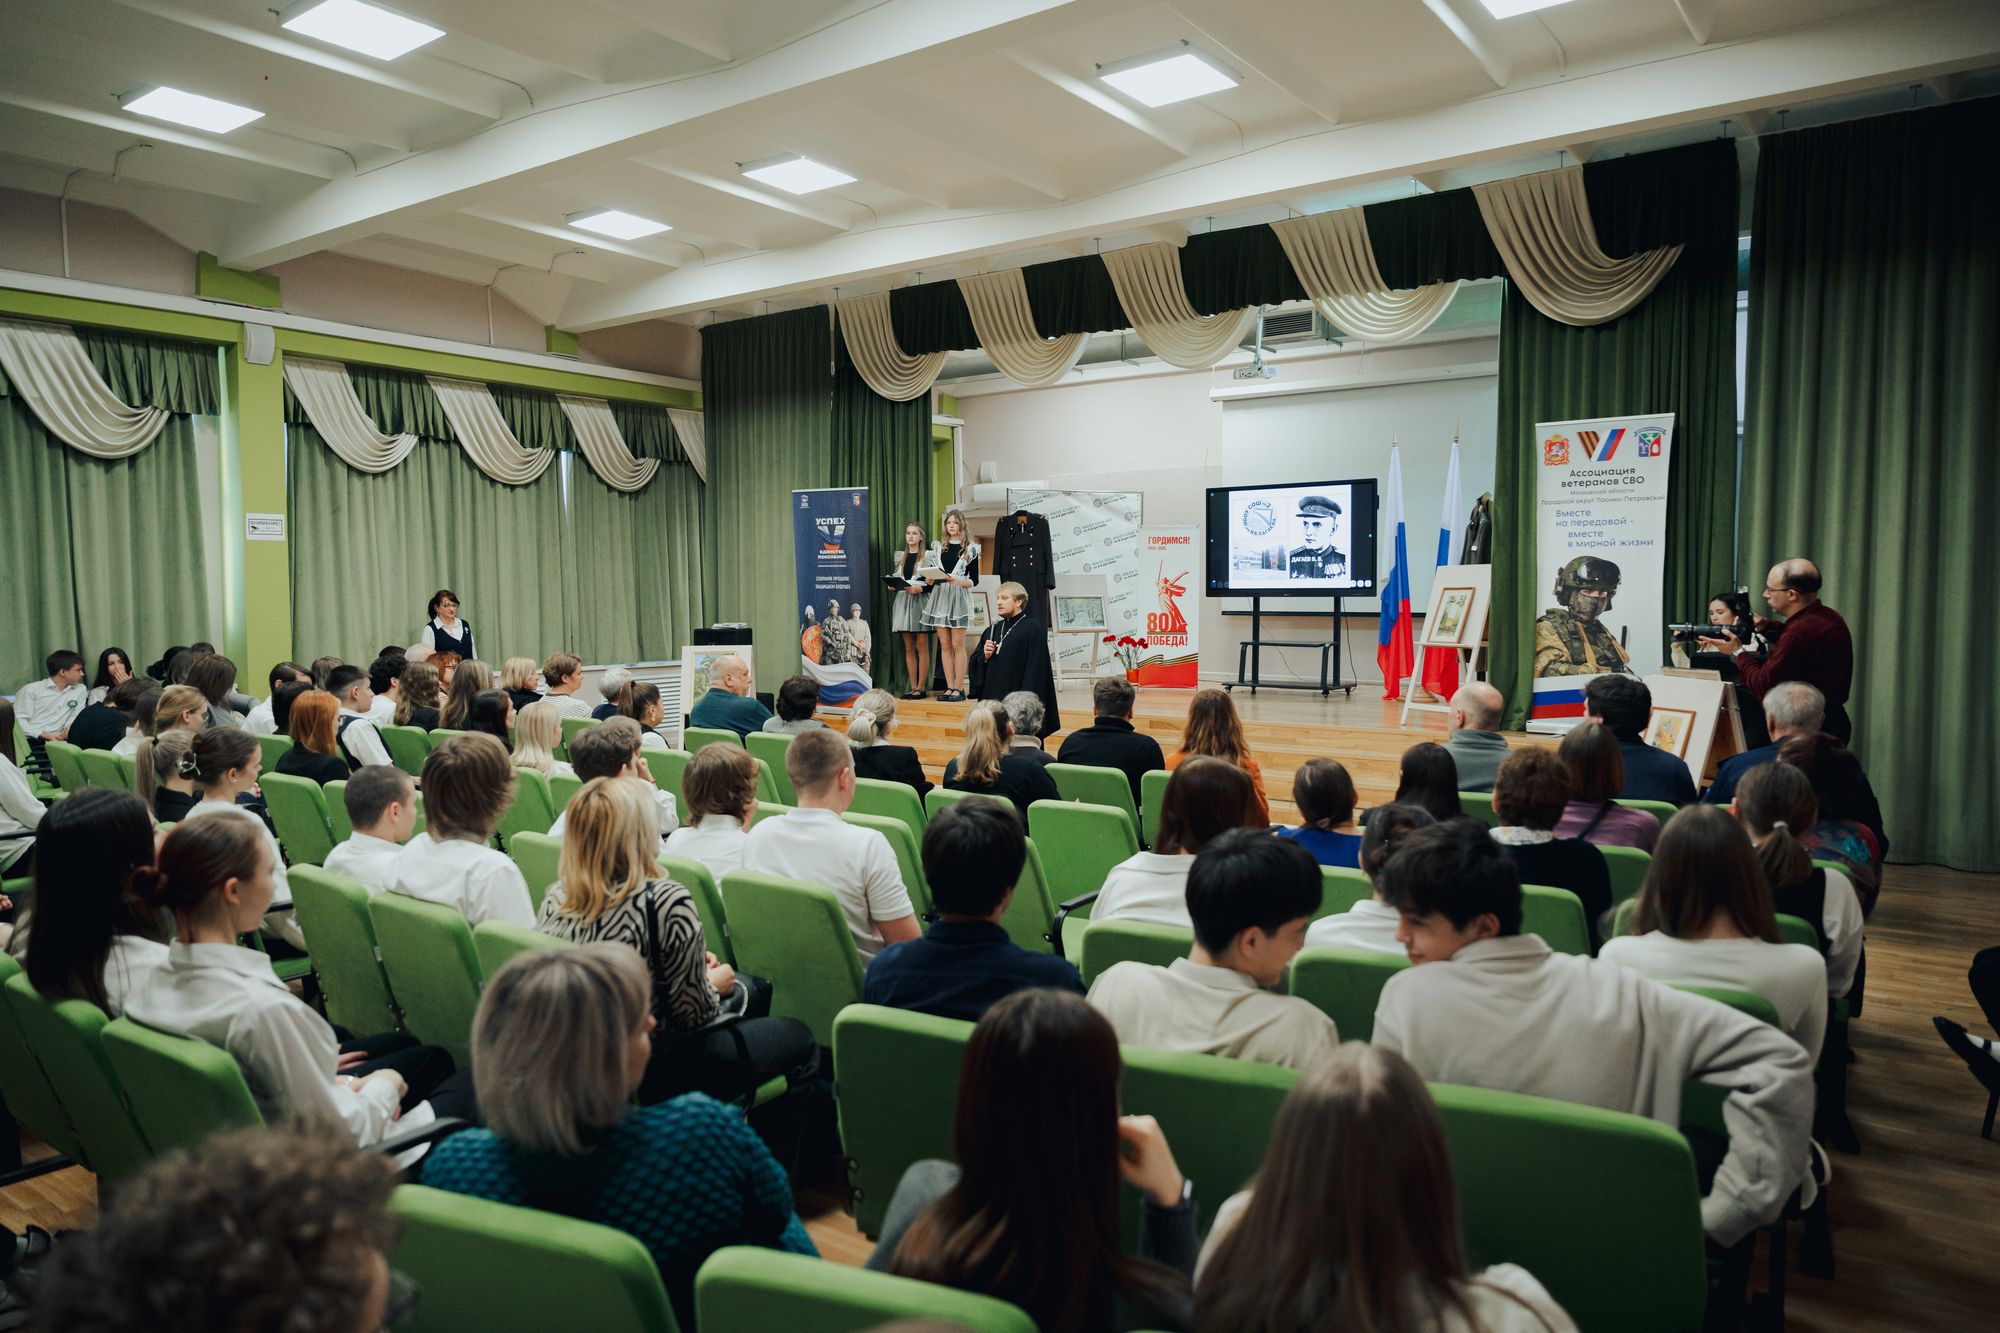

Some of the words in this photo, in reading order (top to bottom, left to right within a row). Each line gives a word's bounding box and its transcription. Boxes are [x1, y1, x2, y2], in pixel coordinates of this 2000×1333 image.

[1569, 467, 1636, 478] Ассоциация
[1561, 478, 1619, 488] ветеранов
[1622, 476, 1645, 485] СВО
[1248, 501, 1261, 510] СОШ
[815, 517, 846, 525] УСПЕХ
[1570, 517, 1627, 527] передовой
[1148, 536, 1190, 545] ГОРДИМСЯ!
[1576, 539, 1616, 549] мирной
[1619, 539, 1654, 547] жизни
[1147, 612, 1169, 632] 80
[1147, 635, 1188, 647] ПОБЕДА!
